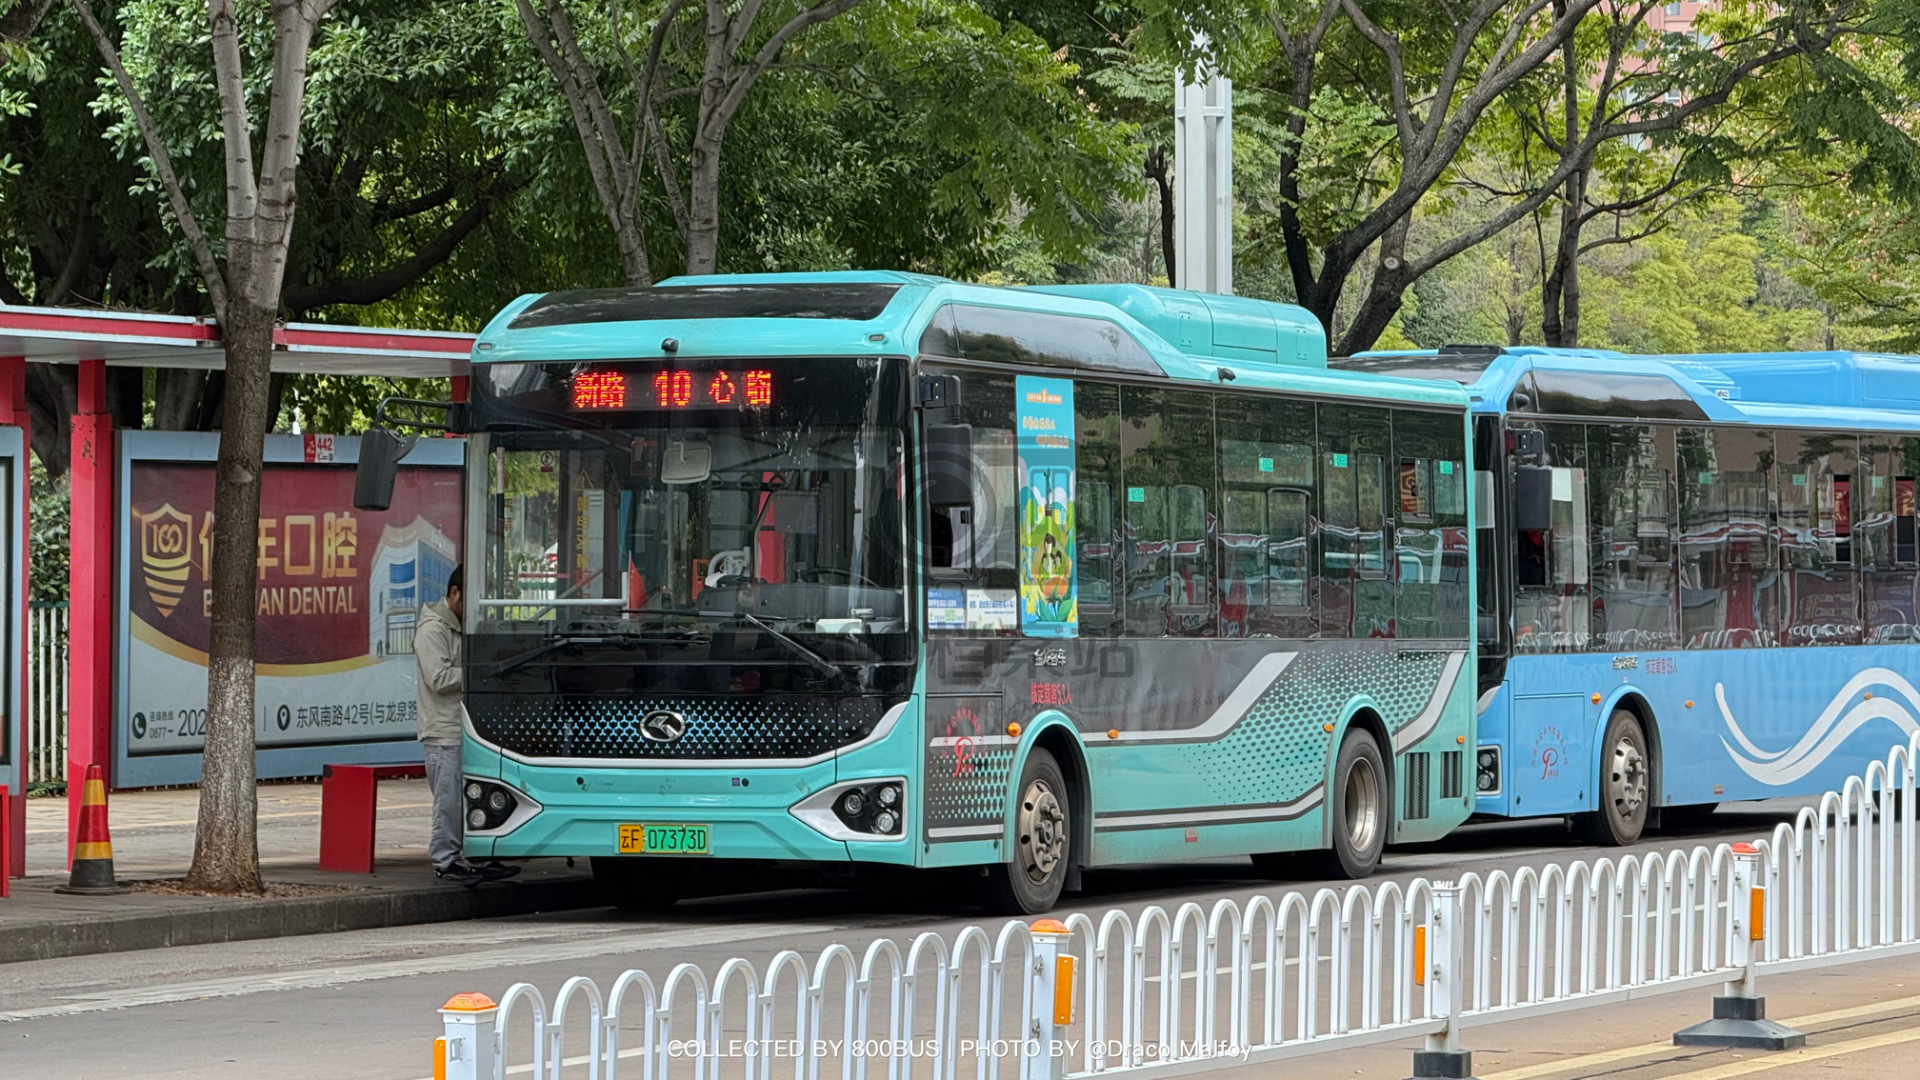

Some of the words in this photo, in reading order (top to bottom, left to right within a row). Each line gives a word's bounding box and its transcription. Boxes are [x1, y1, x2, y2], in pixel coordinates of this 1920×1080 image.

[655, 370, 691, 407] 10
[317, 437, 333, 451] 442
[289, 585, 358, 615] DENTAL
[648, 829, 707, 850] 07373D
